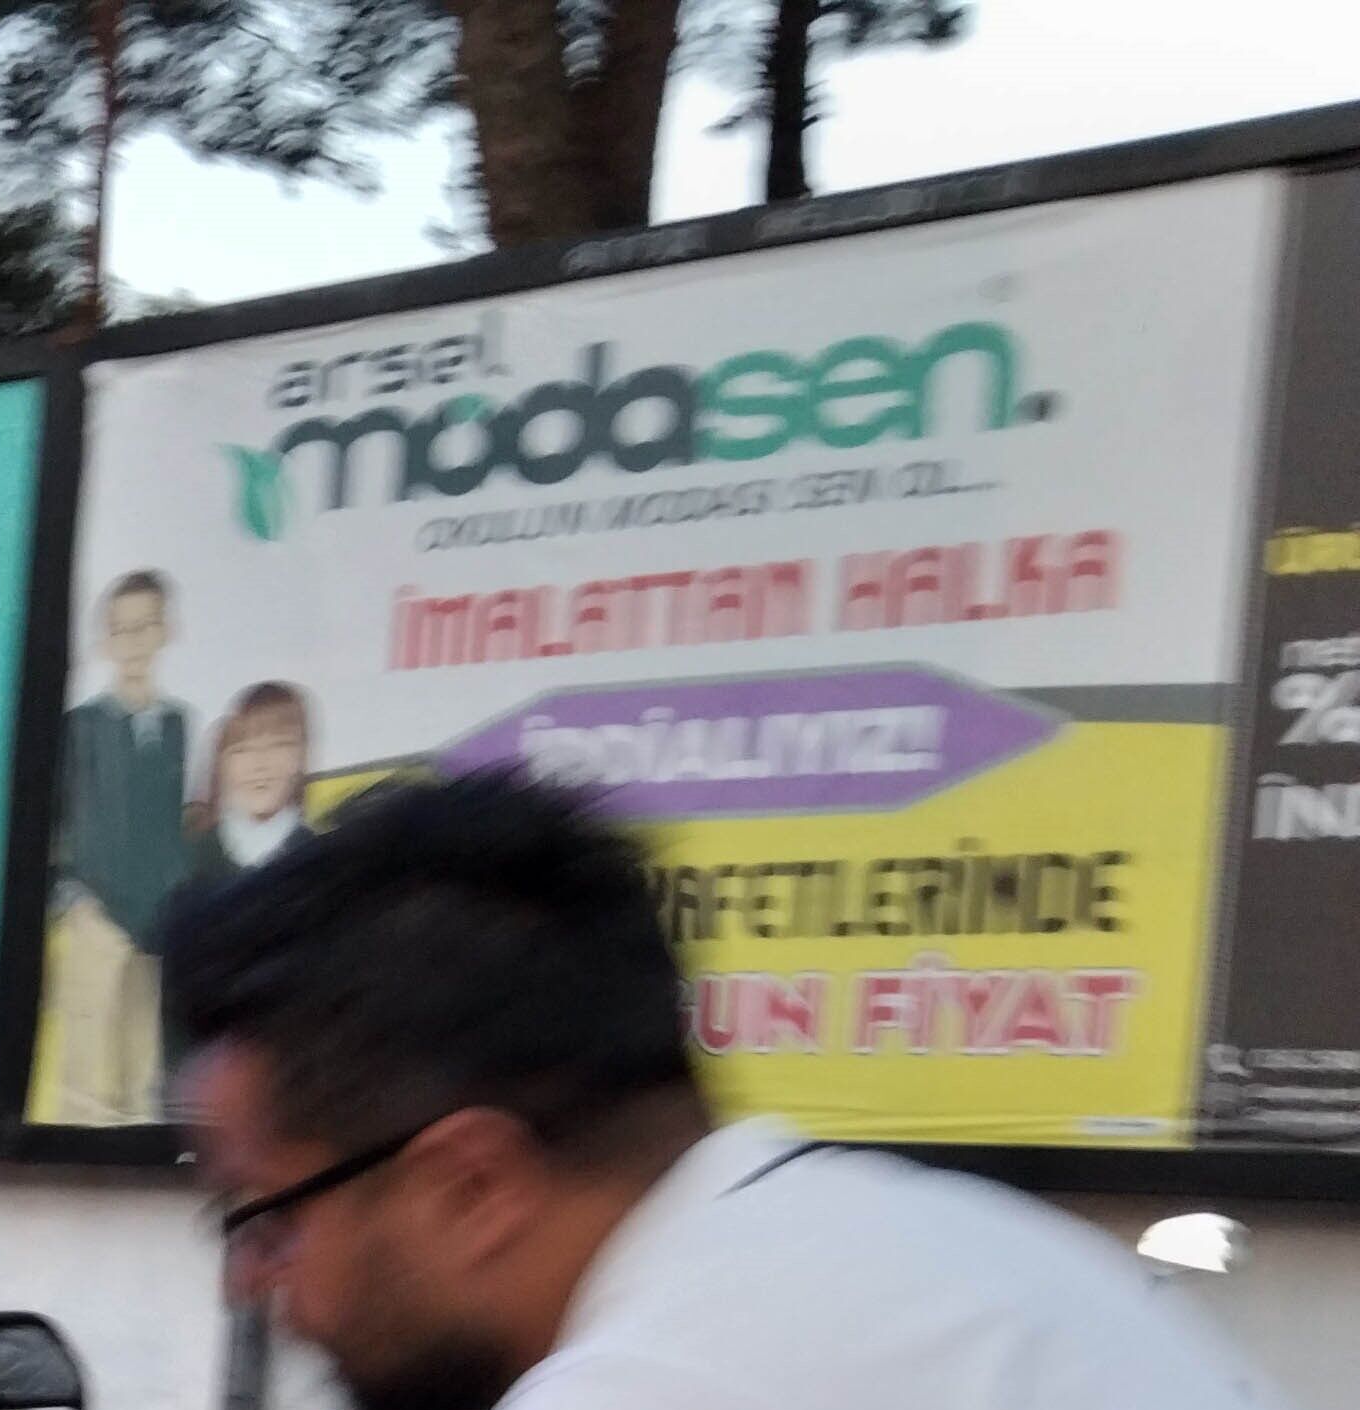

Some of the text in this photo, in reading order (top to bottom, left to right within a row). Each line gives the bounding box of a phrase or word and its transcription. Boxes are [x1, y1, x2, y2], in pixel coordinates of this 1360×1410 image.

[390, 528, 1126, 671] İMALATTAN HALKA
[646, 836, 1130, 941] AFETLERİNDE
[678, 948, 1143, 1056] UN FİYAT
